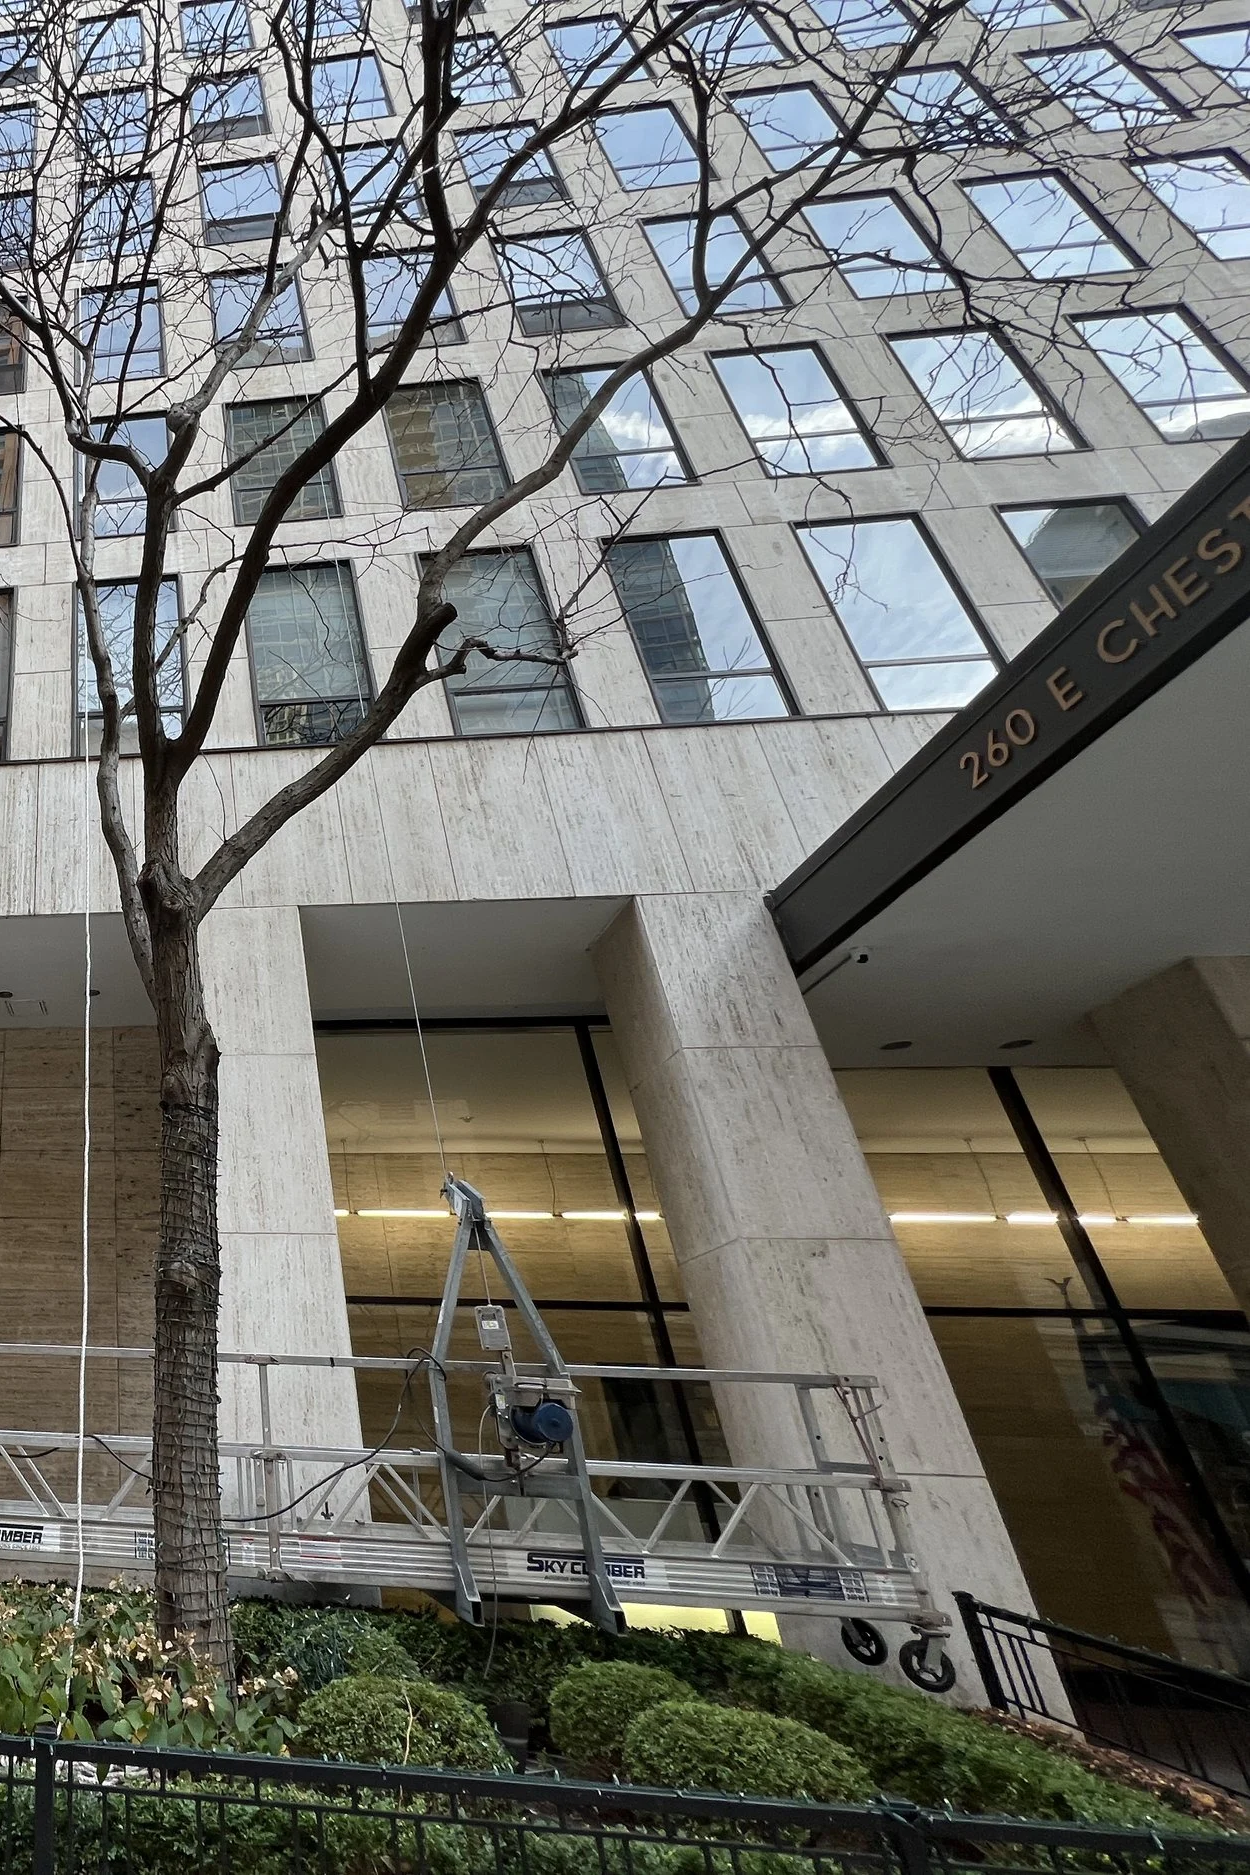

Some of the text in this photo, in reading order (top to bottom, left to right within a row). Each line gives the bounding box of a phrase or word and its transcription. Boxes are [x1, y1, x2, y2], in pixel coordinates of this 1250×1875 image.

[959, 708, 1036, 790] 260
[1046, 666, 1084, 711] E
[527, 1552, 568, 1574] SKY
[570, 1561, 646, 1579] CLBER
